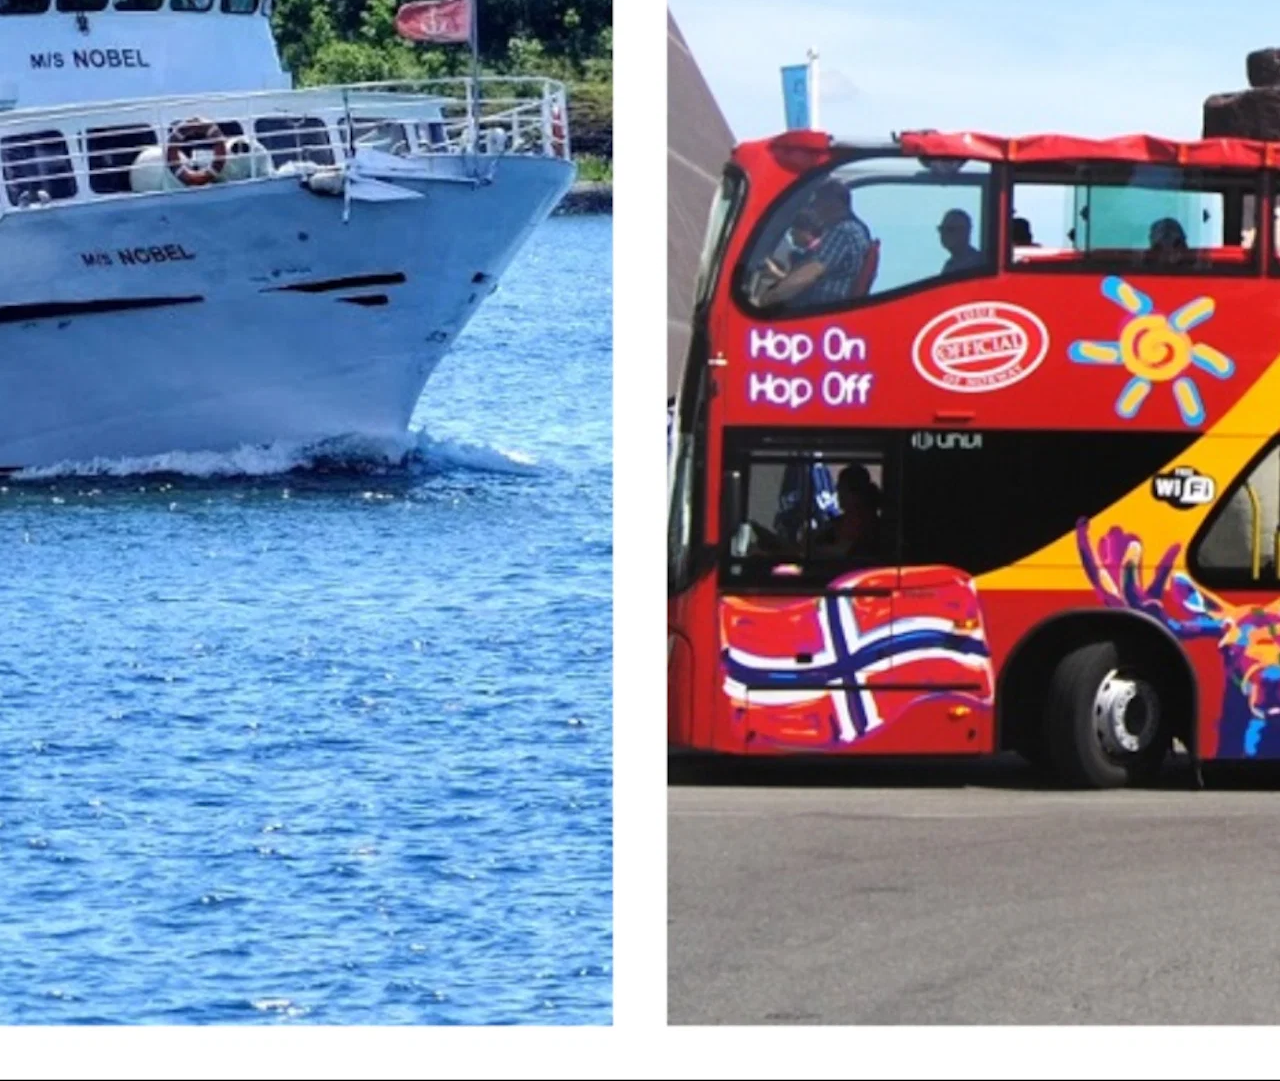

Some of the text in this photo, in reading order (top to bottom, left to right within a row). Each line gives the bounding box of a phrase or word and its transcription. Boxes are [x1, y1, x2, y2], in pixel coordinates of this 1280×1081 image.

[72, 48, 150, 69] NOBEL
[117, 244, 197, 265] NOBEL
[750, 326, 866, 365] Hop On
[938, 331, 1024, 359] OFFICIAL
[750, 370, 873, 408] Hop Off
